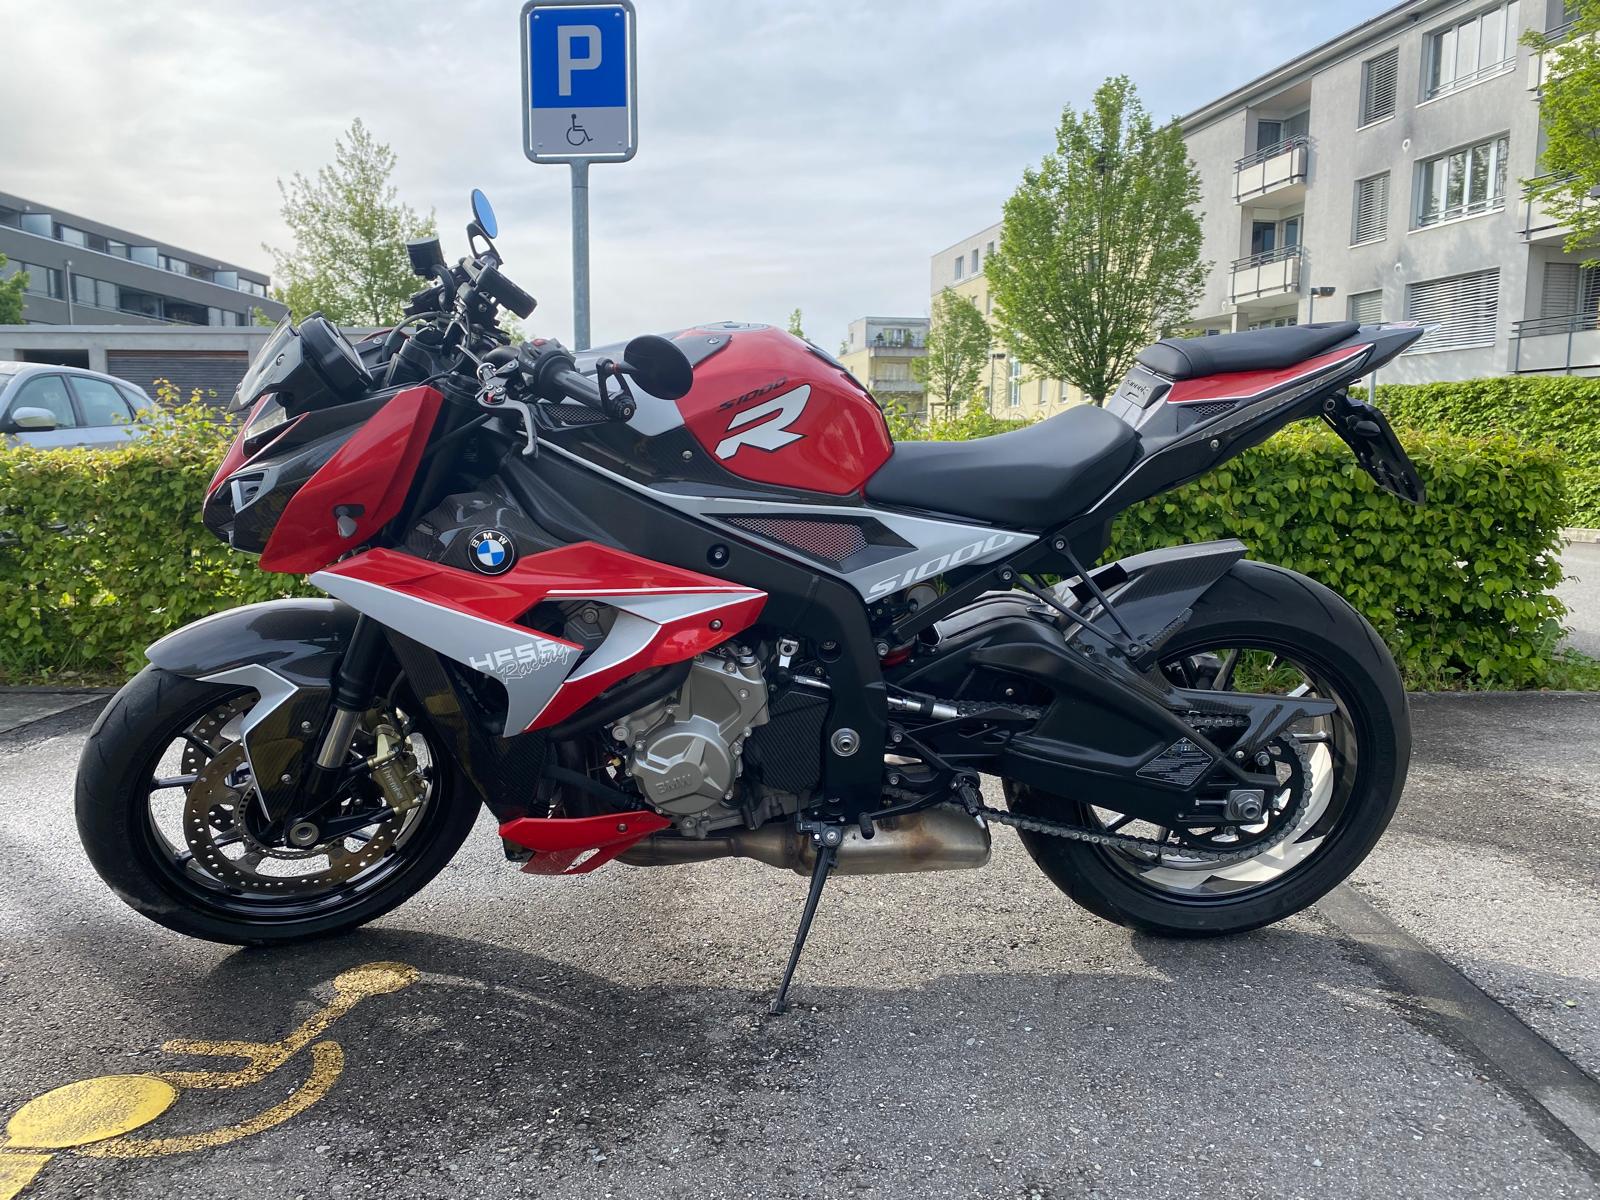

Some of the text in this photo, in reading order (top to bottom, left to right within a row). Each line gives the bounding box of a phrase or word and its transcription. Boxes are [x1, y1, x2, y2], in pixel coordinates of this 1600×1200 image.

[557, 24, 602, 96] P
[717, 377, 787, 412] S1000
[713, 382, 812, 460] R
[471, 532, 508, 548] BMW
[865, 534, 1014, 599] S1000
[496, 644, 570, 684] Racing
[655, 773, 691, 793] BMW
